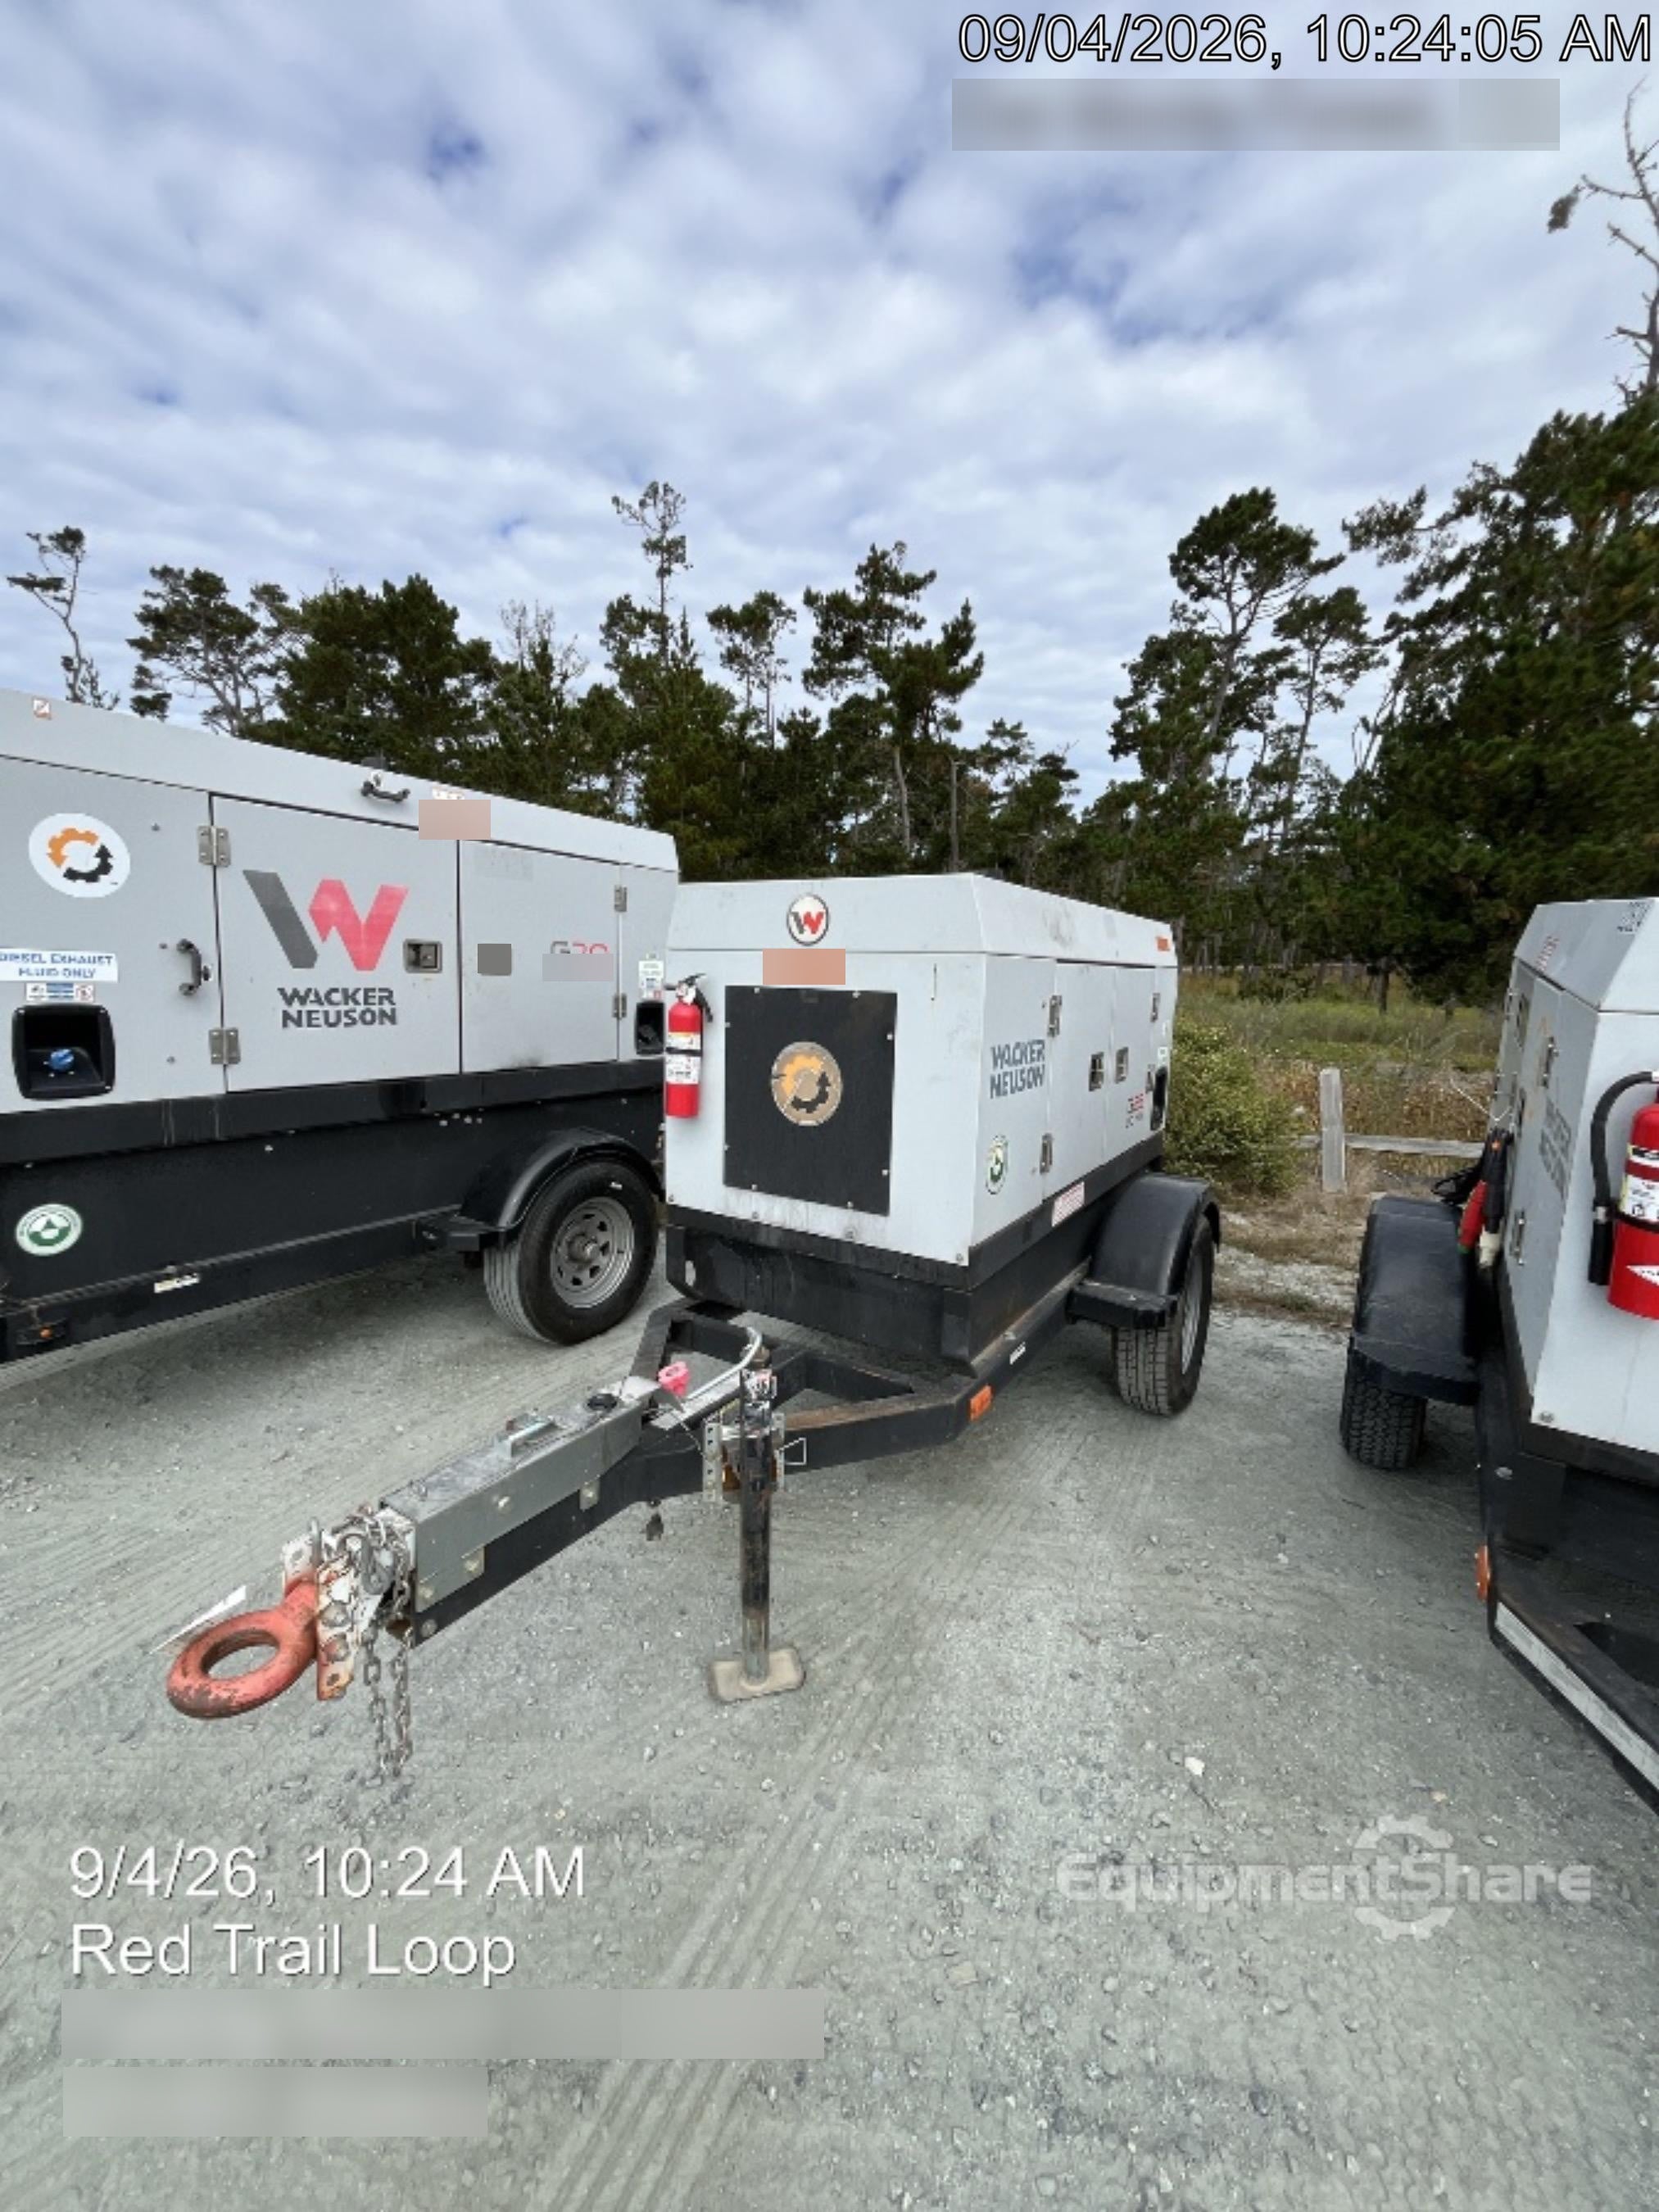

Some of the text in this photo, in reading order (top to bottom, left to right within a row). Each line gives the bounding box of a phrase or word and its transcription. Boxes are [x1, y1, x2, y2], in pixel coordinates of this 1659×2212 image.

[51, 953, 113, 966] EXHAUST
[62, 968, 96, 979] ONLY
[277, 987, 397, 1007] WACKER
[282, 1008, 398, 1028] NEUSON
[990, 1039, 1046, 1071] WACKER
[990, 1064, 1046, 1099] NEUSON
